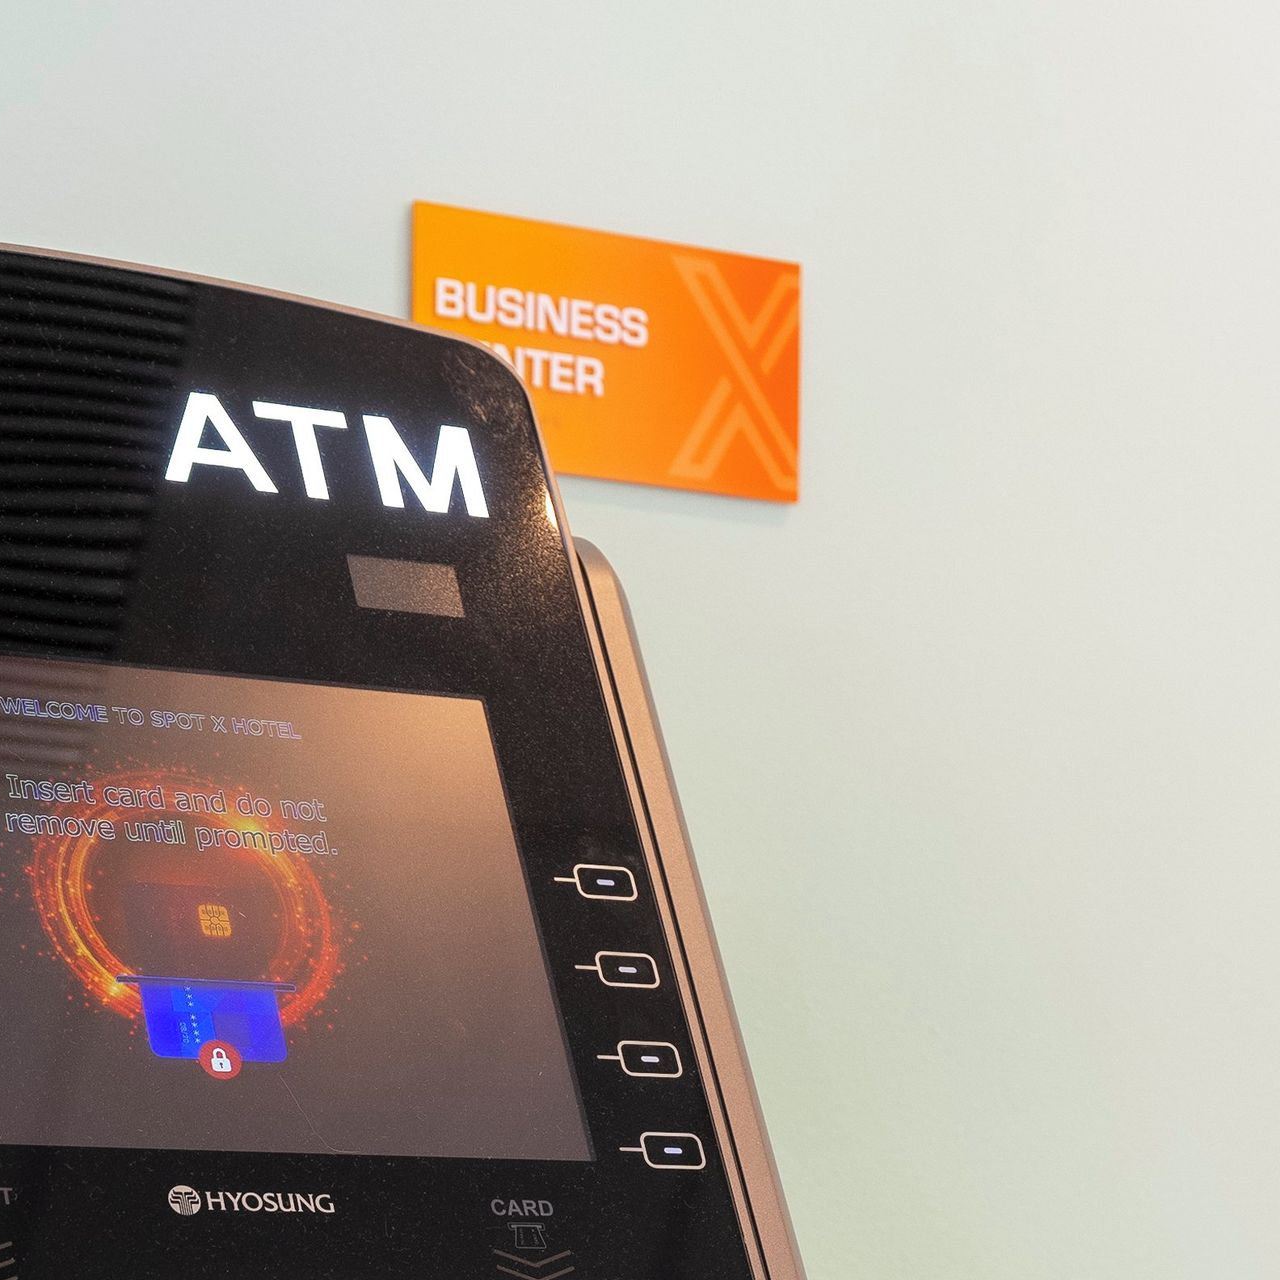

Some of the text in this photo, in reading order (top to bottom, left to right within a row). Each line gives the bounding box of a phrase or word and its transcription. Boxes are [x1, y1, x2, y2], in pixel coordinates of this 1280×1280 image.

[434, 276, 649, 348] BUSINESS
[163, 391, 489, 518] ATM
[112, 706, 144, 726] TO
[150, 710, 205, 732] SPOT
[211, 715, 226, 734] X
[231, 717, 302, 740] HOTEL
[6, 774, 327, 823] Insert card and do not
[4, 810, 339, 857] remove until prompted.
[205, 1191, 335, 1213] HYOSUNG
[490, 1199, 554, 1217] CARD
